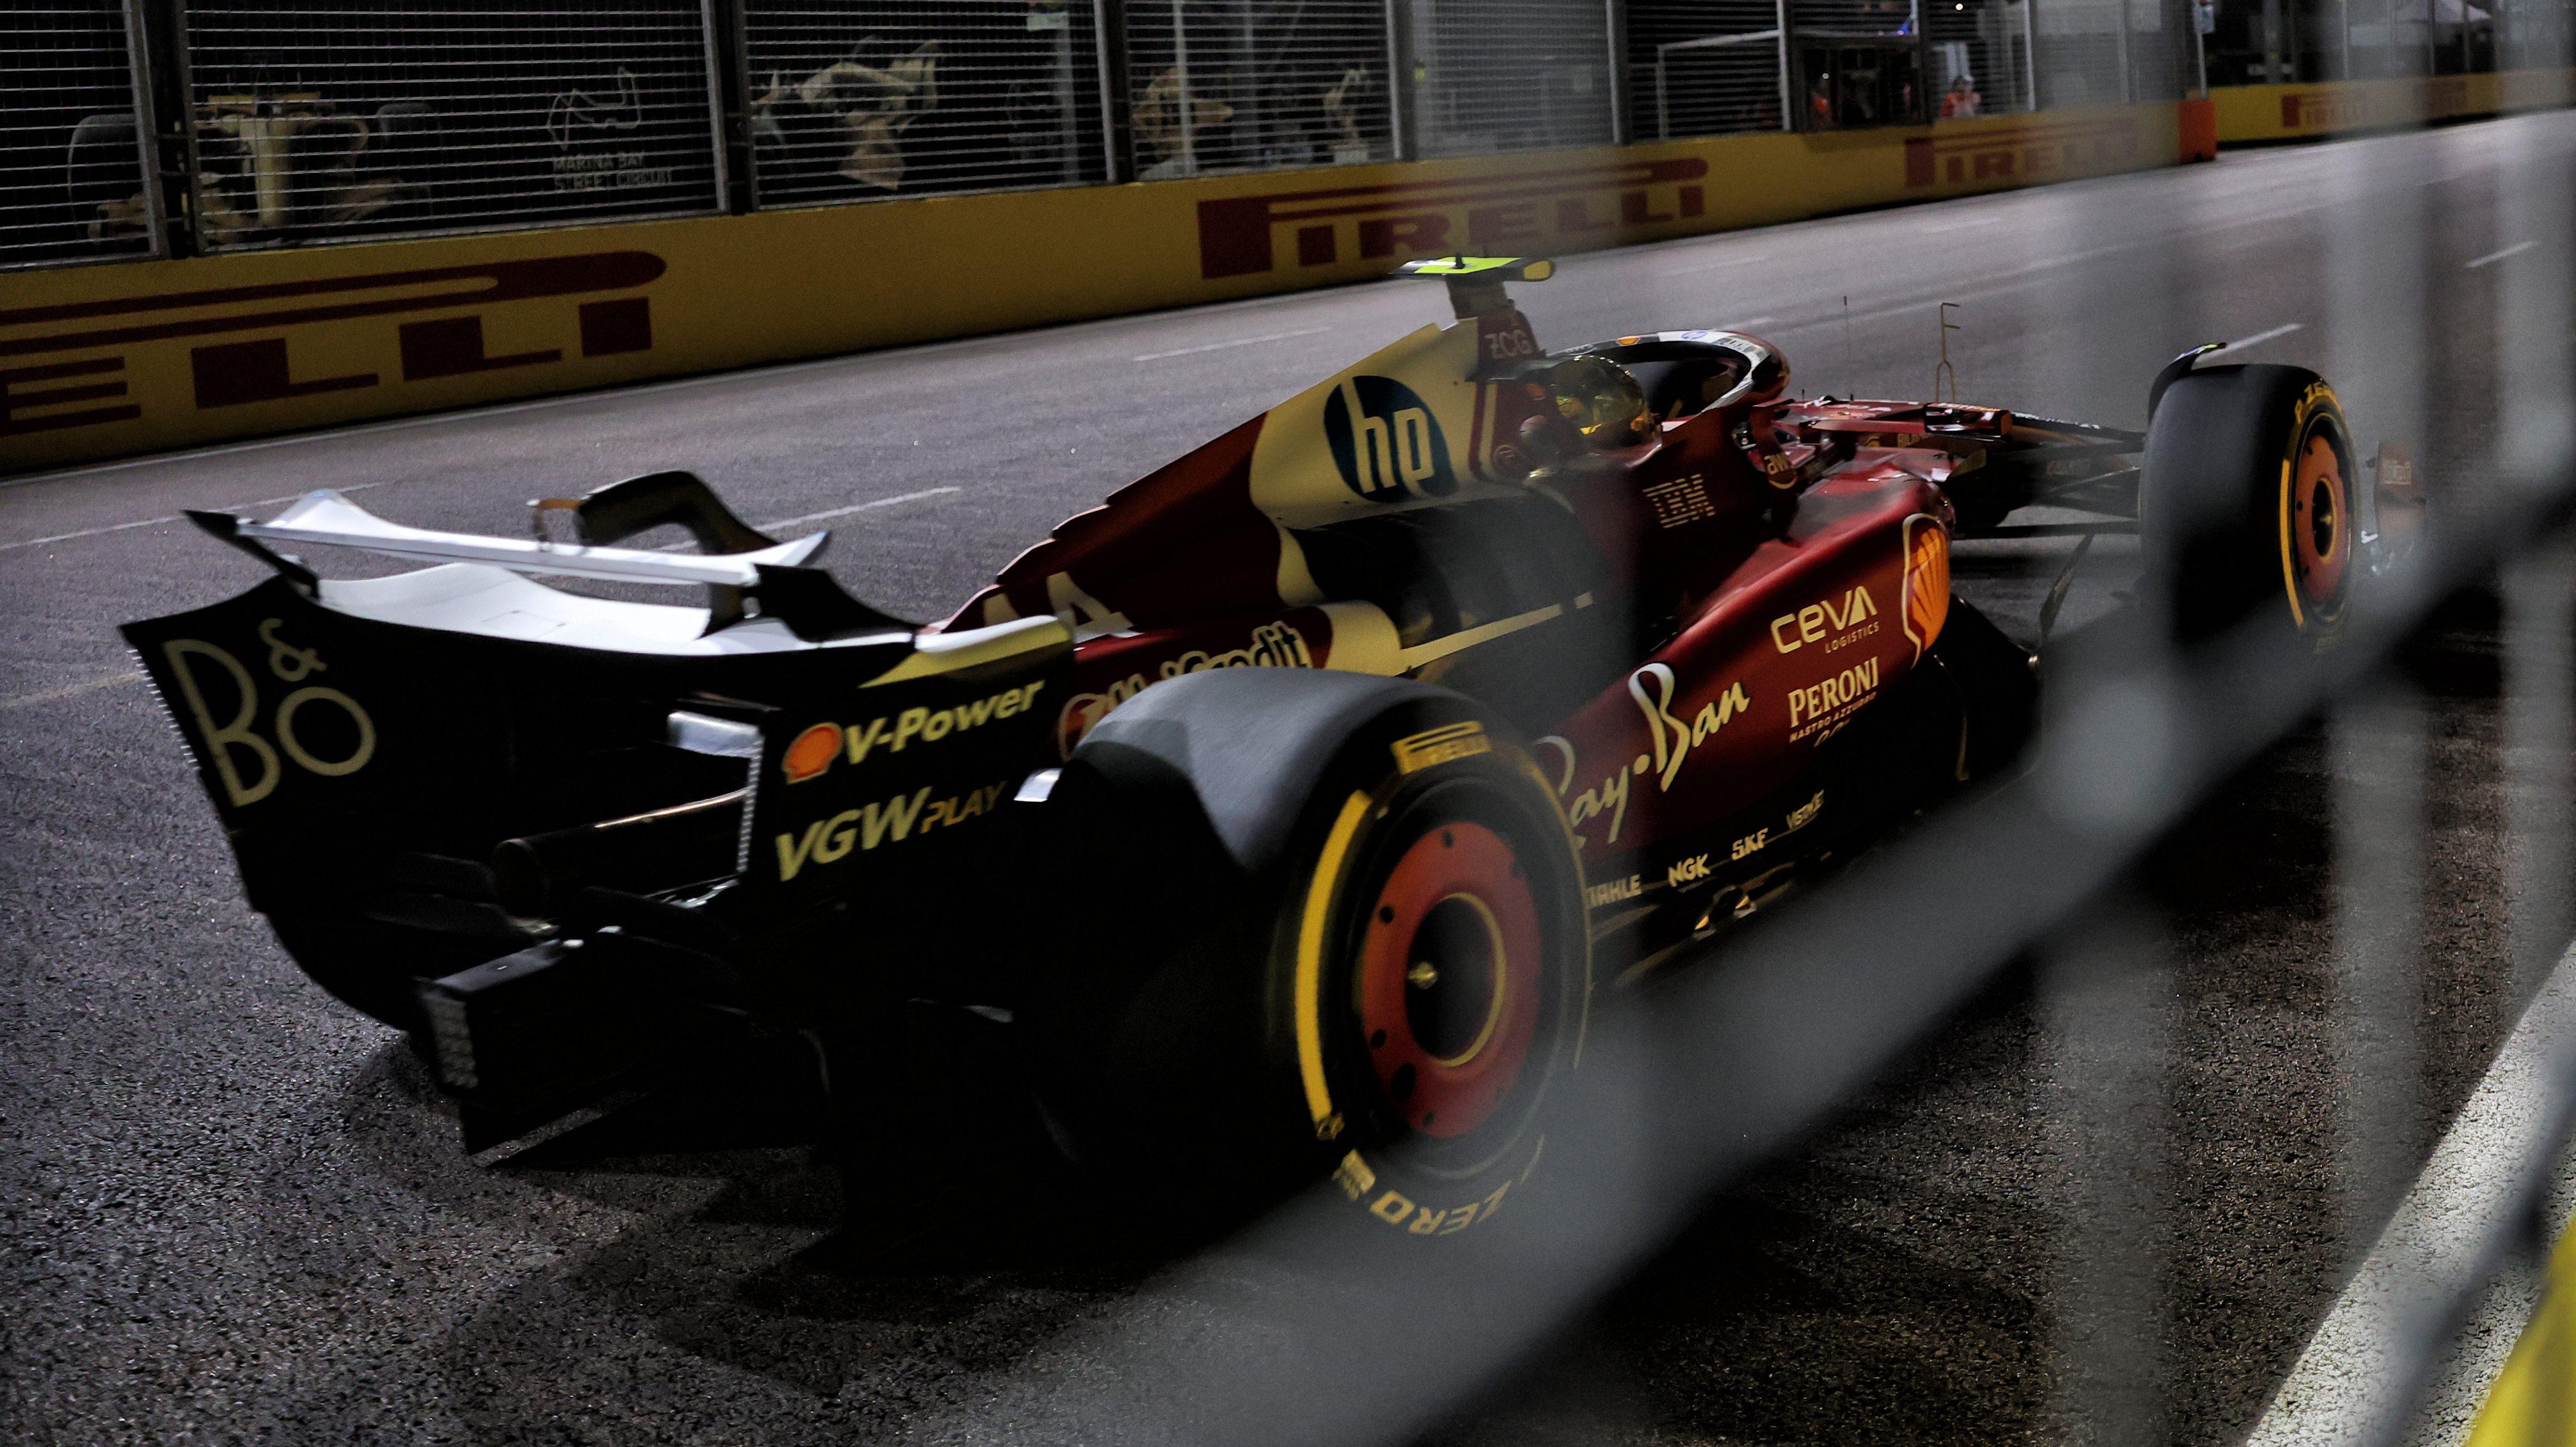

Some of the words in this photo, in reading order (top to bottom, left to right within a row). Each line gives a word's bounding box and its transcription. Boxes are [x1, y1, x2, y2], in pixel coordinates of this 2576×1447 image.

[1198, 158, 1708, 278] PIRELLI
[0, 252, 667, 437] ELLI
[1339, 376, 1435, 498] hp
[1642, 473, 1717, 529] IBM
[1825, 621, 1880, 653] LOGISTICS
[843, 679, 1047, 766] V-Power
[1787, 655, 1880, 728] PERONI
[1789, 715, 1833, 743] NASTRO
[775, 784, 933, 882] VGW
[1667, 853, 1712, 887] NGK
[1731, 827, 1770, 861] SKF
[1369, 1179, 1513, 1236] ZERO
